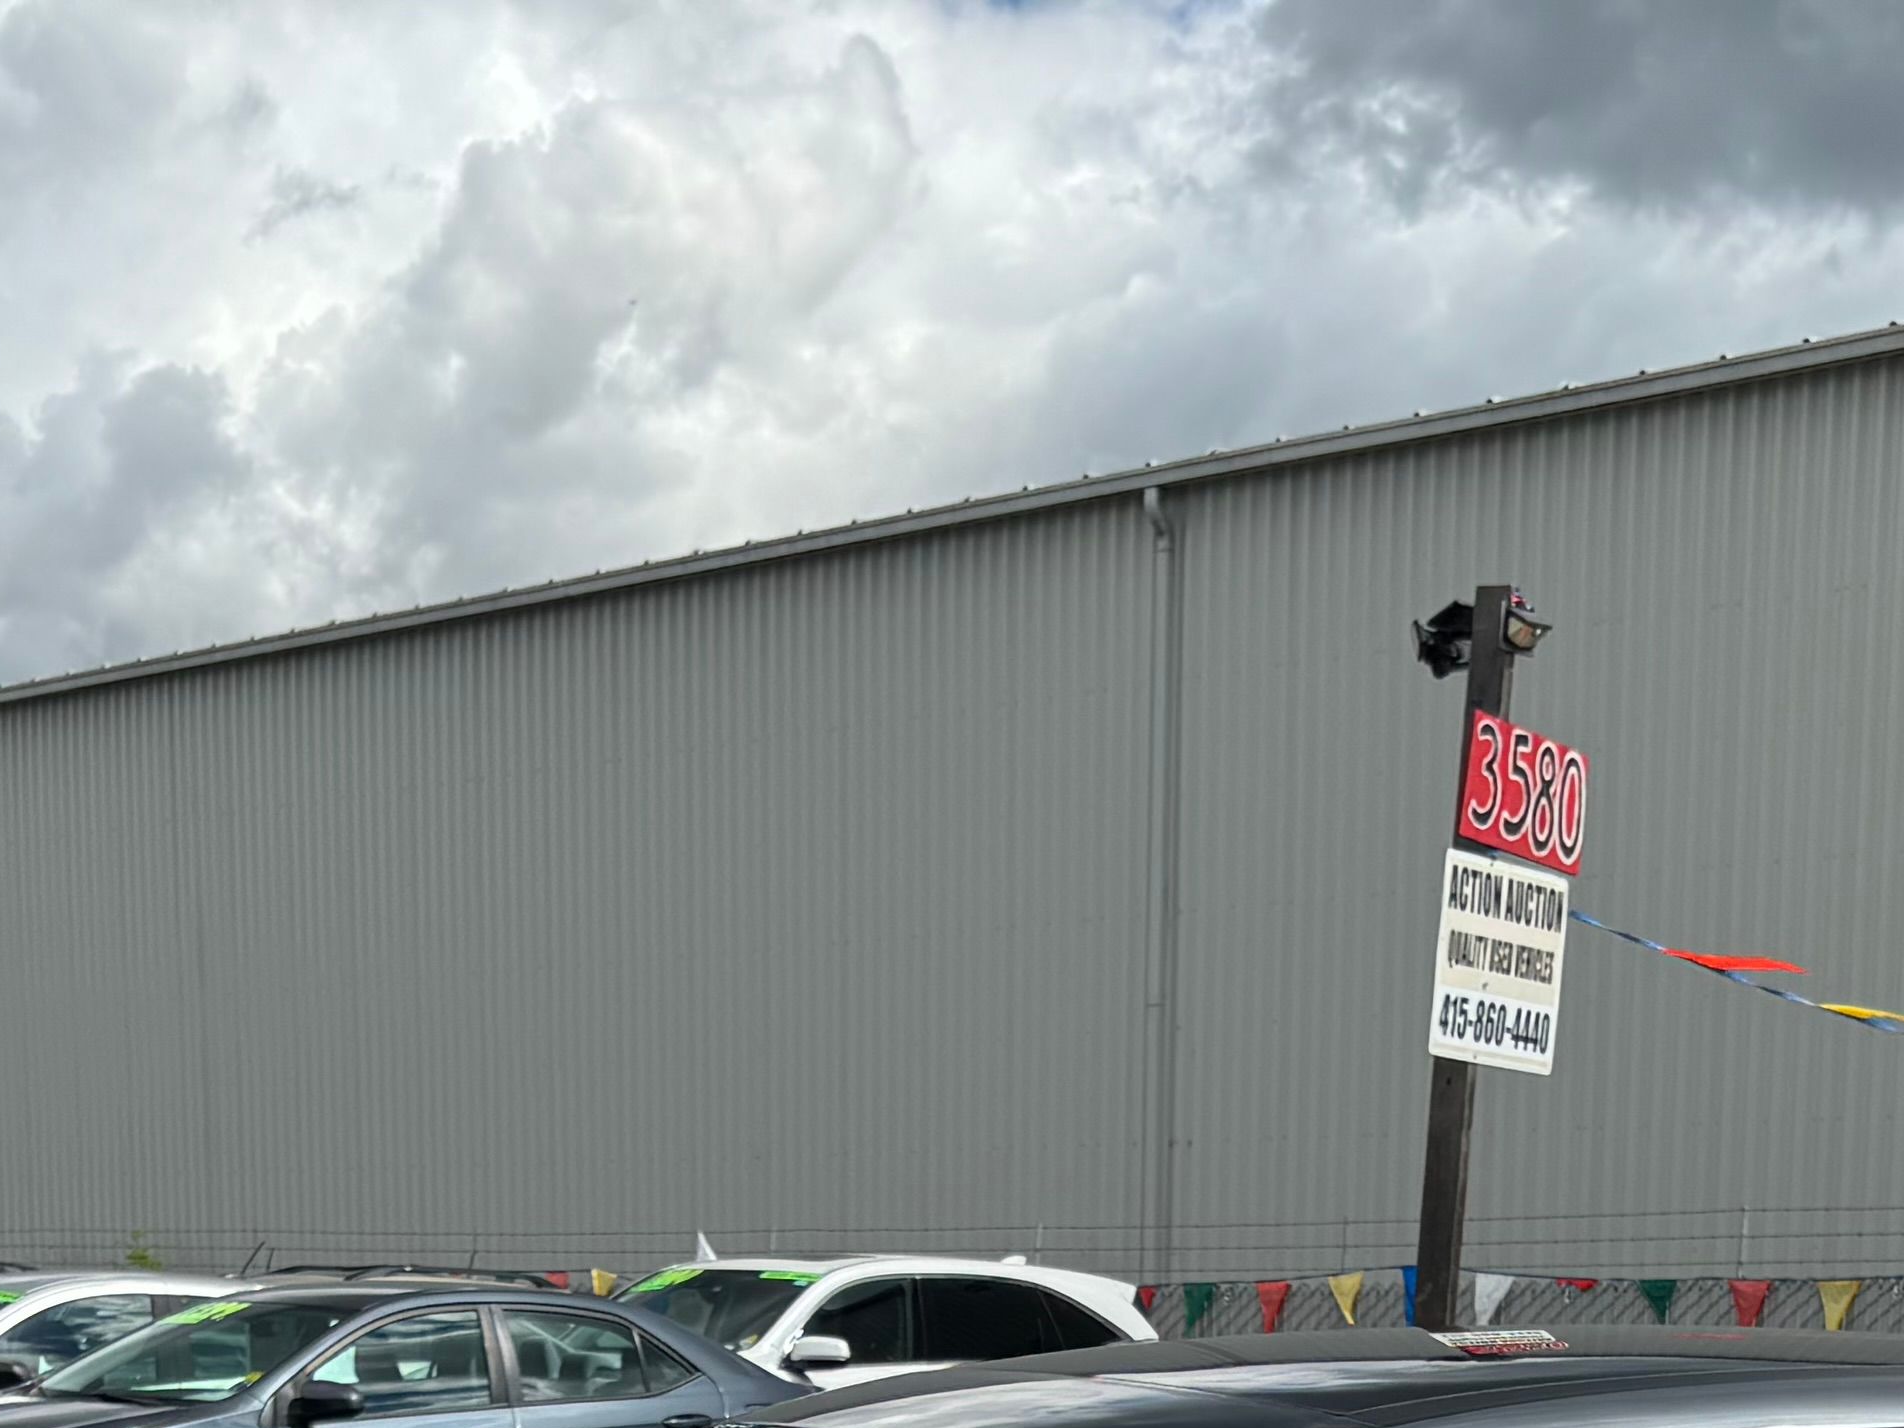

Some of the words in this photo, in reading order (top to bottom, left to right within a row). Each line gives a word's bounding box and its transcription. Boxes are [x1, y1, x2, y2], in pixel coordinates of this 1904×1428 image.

[1467, 717, 1586, 867] 3580
[1448, 864, 1503, 919] ACTION
[1504, 878, 1564, 933] AUCTION
[1447, 929, 1488, 968] QUALITY
[1489, 938, 1514, 976] USED
[1514, 944, 1555, 984] VEHICLES
[1439, 993, 1551, 1055] 415-860-4440
